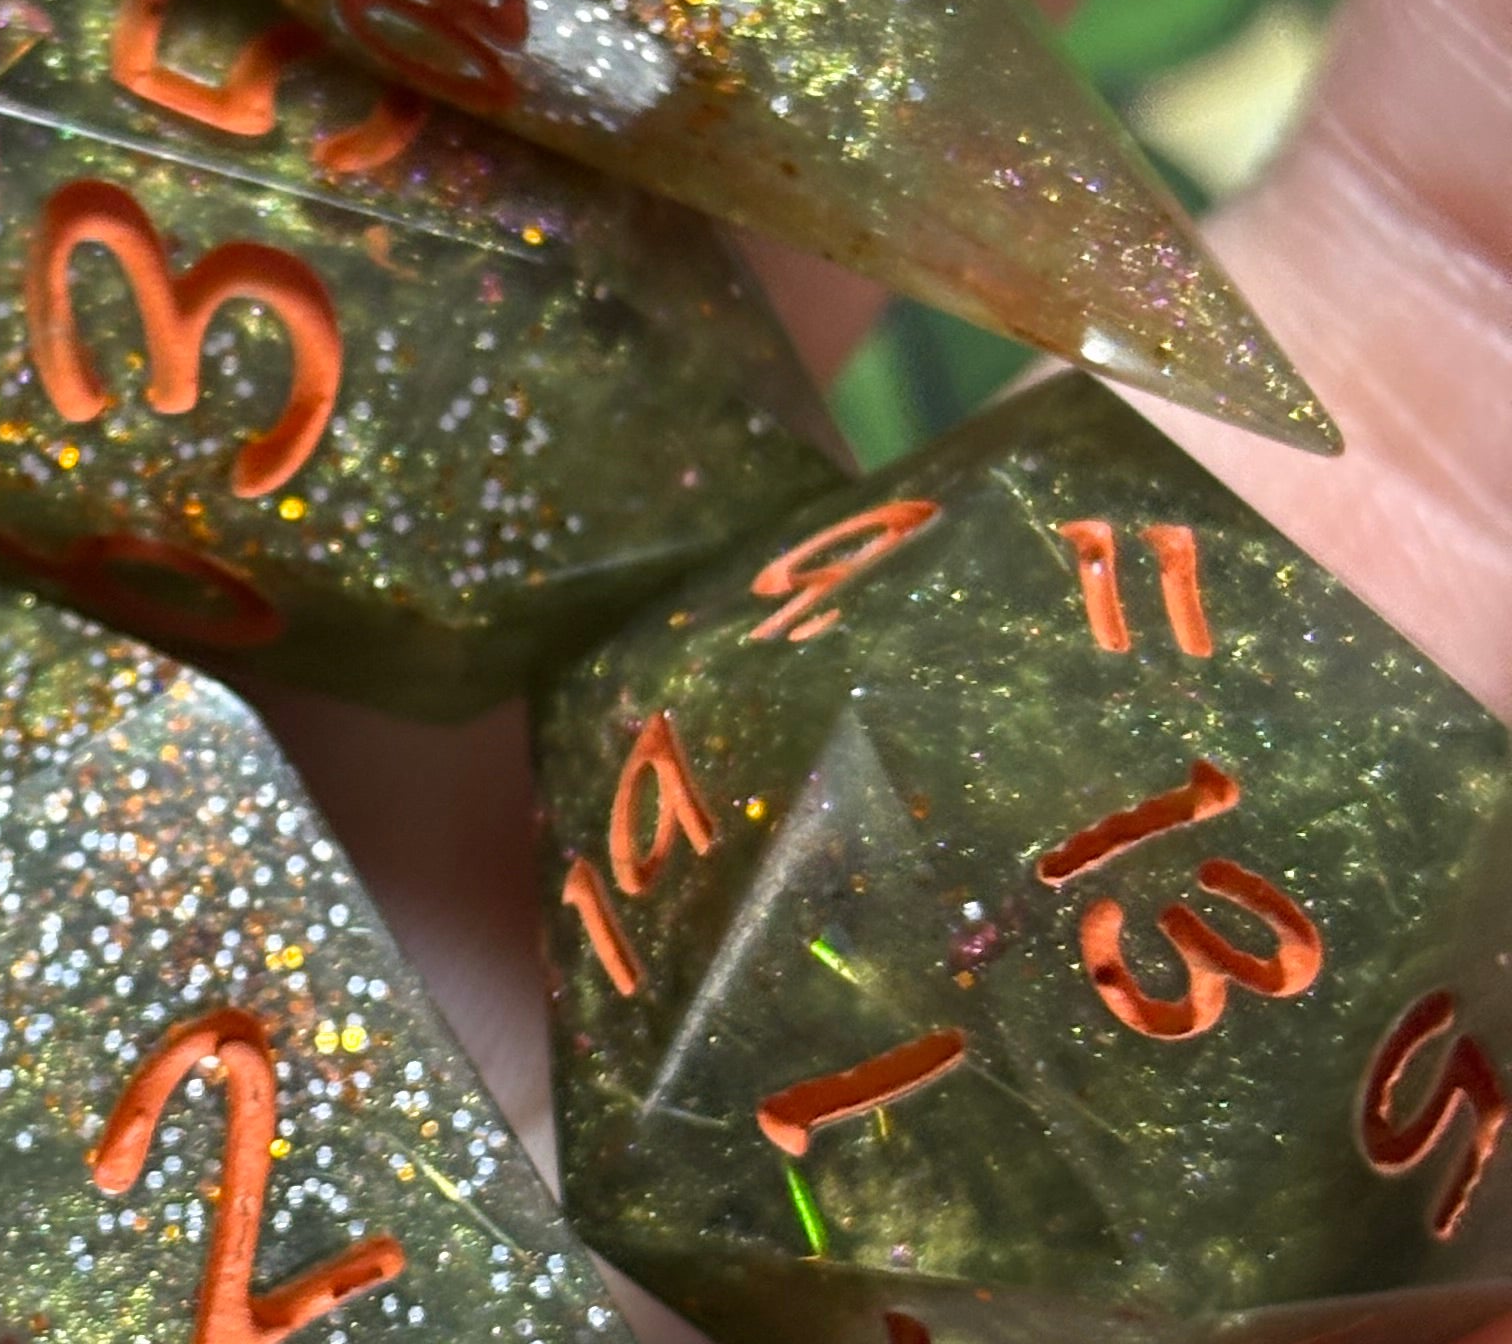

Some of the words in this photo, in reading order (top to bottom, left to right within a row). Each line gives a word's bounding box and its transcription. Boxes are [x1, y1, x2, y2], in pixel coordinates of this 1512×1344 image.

[24, 179, 342, 500] 3
[1058, 520, 1212, 657] 11
[562, 709, 716, 998] 19
[1036, 758, 1323, 1040] 13
[755, 1026, 967, 1157] 1
[1360, 987, 1510, 1241] 5
